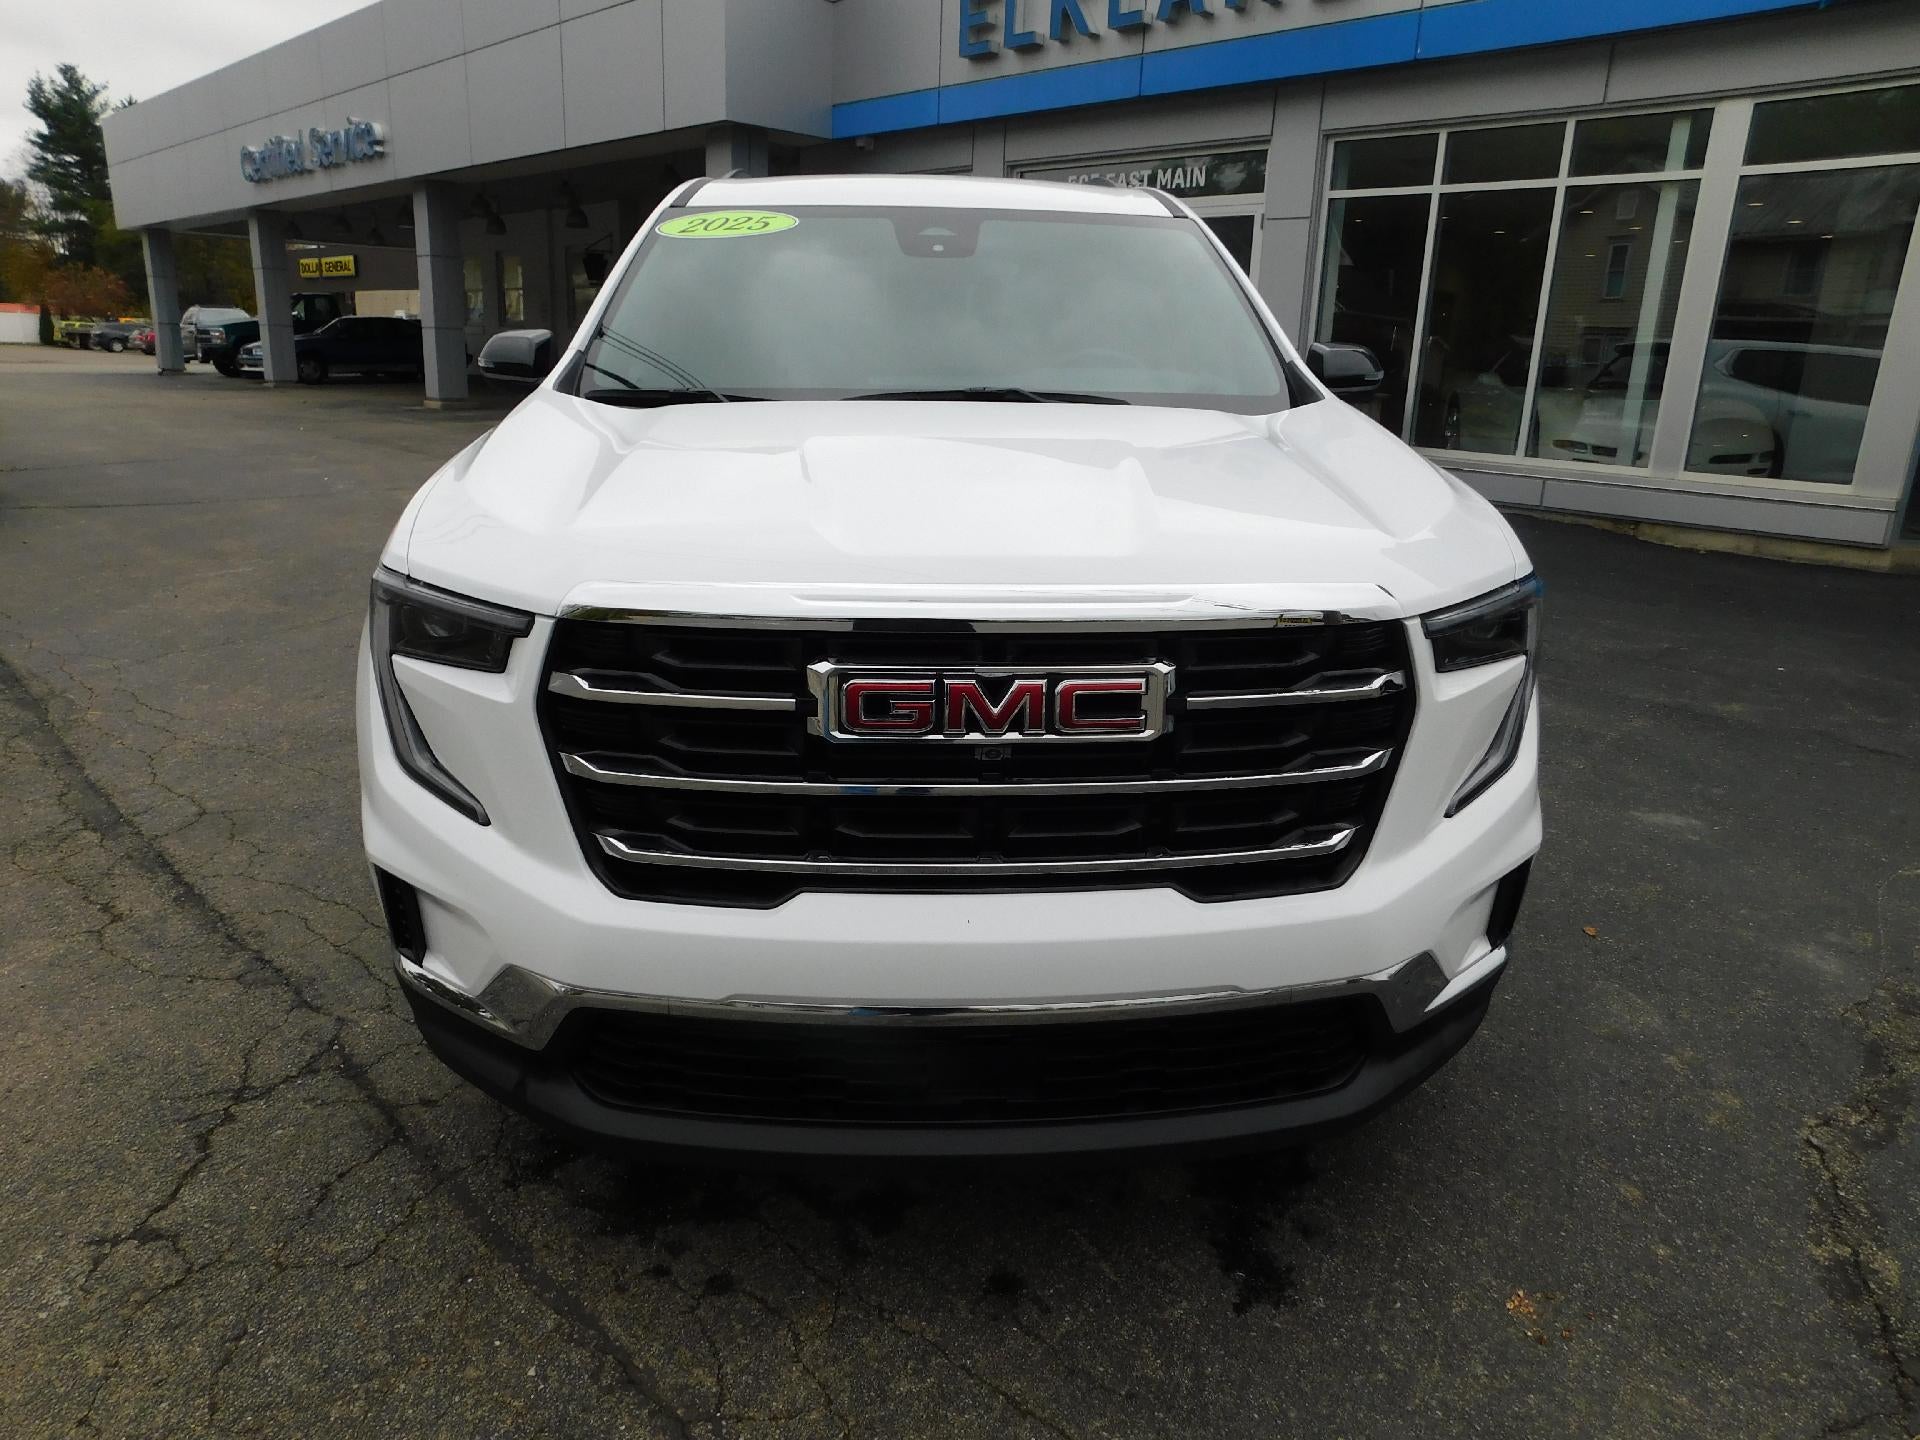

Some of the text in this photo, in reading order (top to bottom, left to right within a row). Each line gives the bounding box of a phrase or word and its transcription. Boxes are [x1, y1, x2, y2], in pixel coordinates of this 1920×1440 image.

[239, 116, 382, 182] Certified Service
[1157, 166, 1206, 189] MAIN
[677, 216, 777, 234] 2025
[324, 260, 352, 272] GENERAL
[841, 678, 1147, 734] GMC
